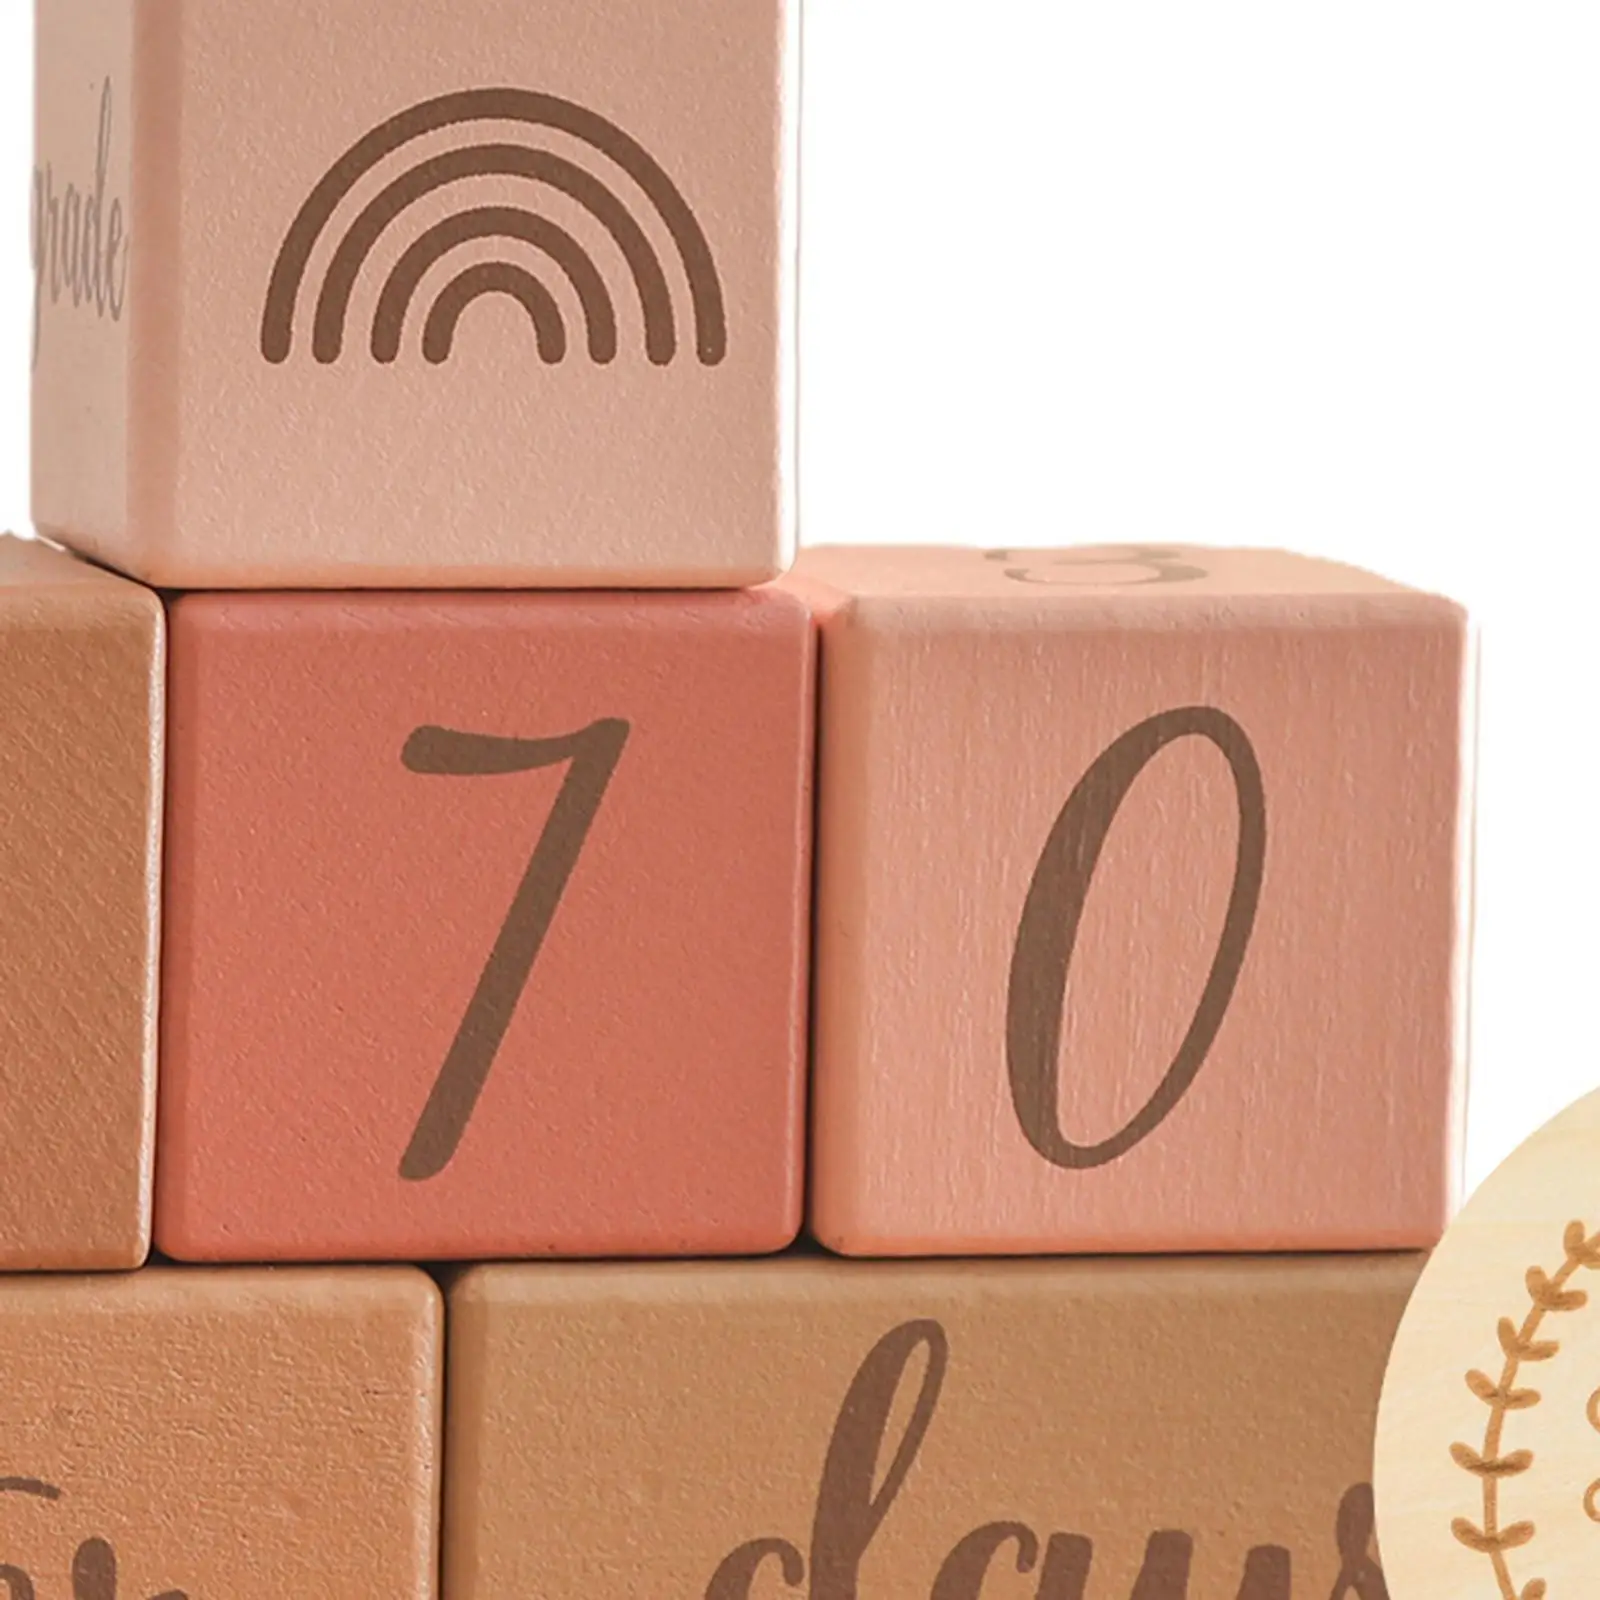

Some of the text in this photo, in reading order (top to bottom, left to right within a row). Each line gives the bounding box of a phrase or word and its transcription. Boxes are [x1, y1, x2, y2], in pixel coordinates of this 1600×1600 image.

[983, 544, 1209, 585] 3
[400, 717, 630, 1180] 7
[1006, 706, 1266, 1169] 0
